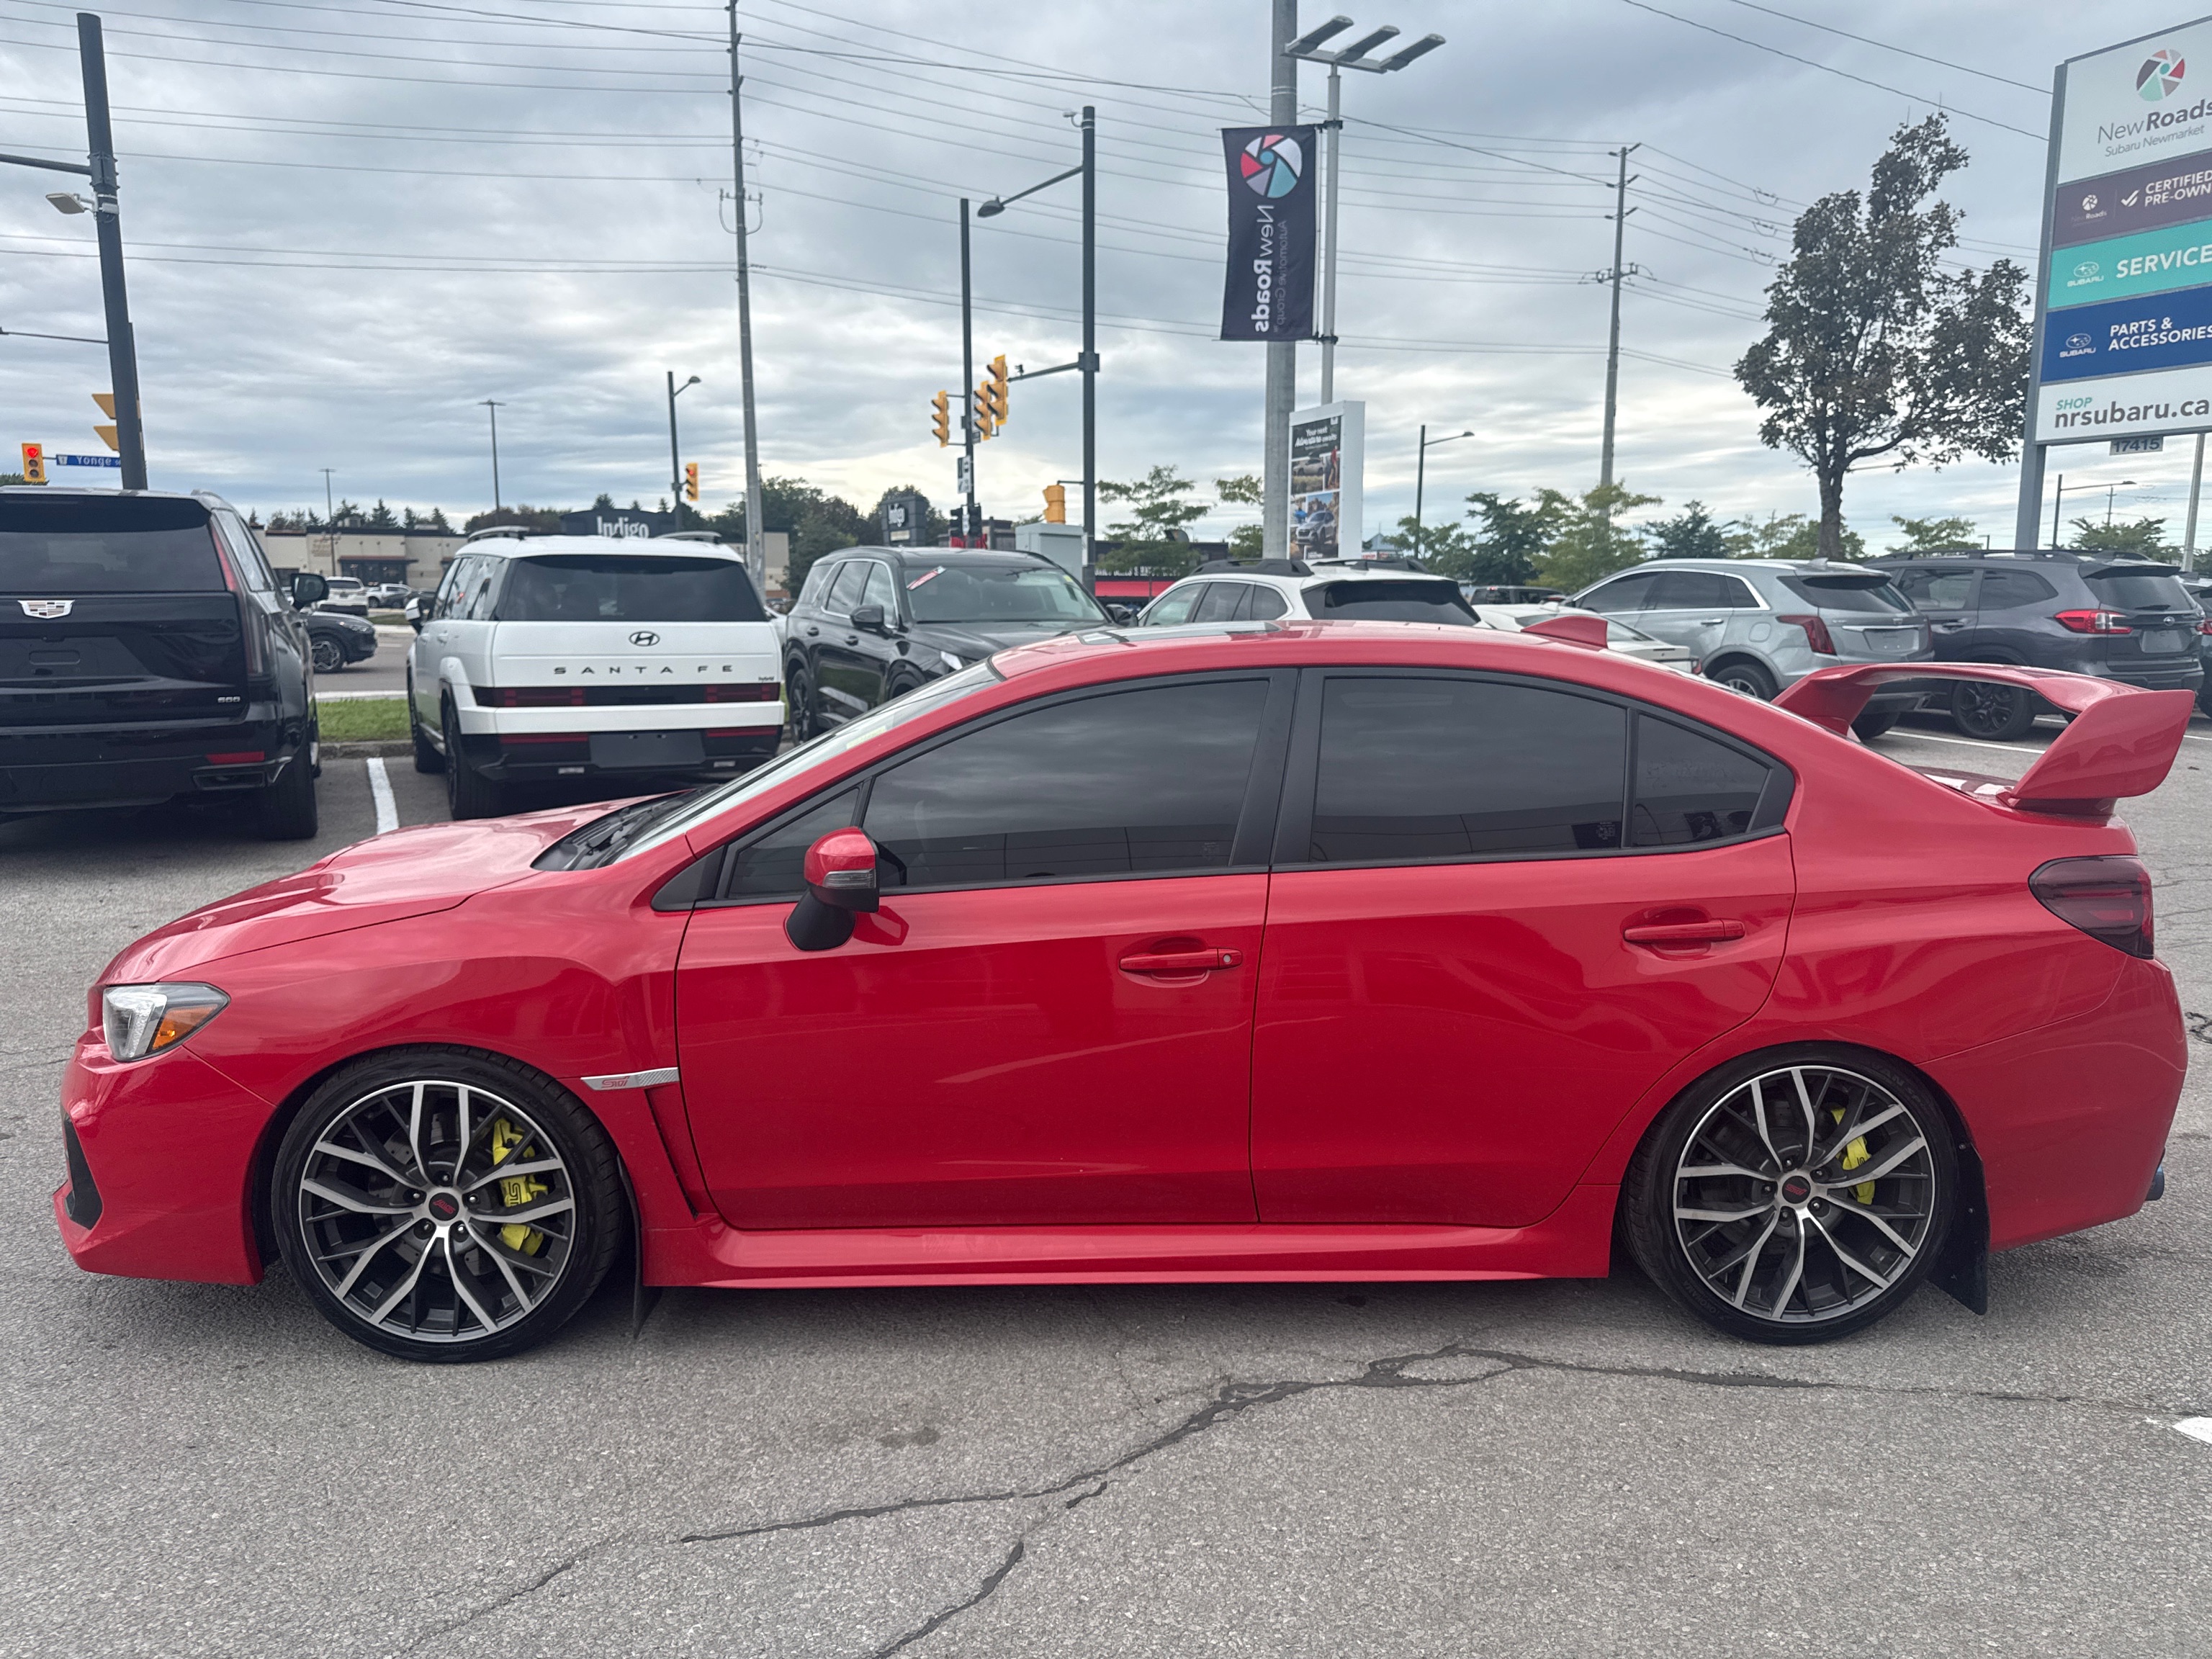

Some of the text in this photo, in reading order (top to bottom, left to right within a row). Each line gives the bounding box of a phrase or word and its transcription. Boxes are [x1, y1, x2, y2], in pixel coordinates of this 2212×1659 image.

[2105, 125, 2205, 157] Subaru Newmarket
[2145, 170, 2212, 194] CERTIFIED
[2144, 183, 2212, 207] PRE-OWN
[2116, 244, 2212, 279] SERVICE
[2067, 275, 2104, 287] SUBARU
[2110, 317, 2172, 337] PARTS &
[2059, 347, 2096, 358] SUBARU
[2054, 399, 2210, 428] nrsubaru.ca
[2056, 397, 2092, 410] SHOP
[2113, 438, 2160, 453] 17415
[76, 456, 112, 467] Yonge
[597, 516, 649, 539] Indigo
[553, 666, 674, 675] SANTA
